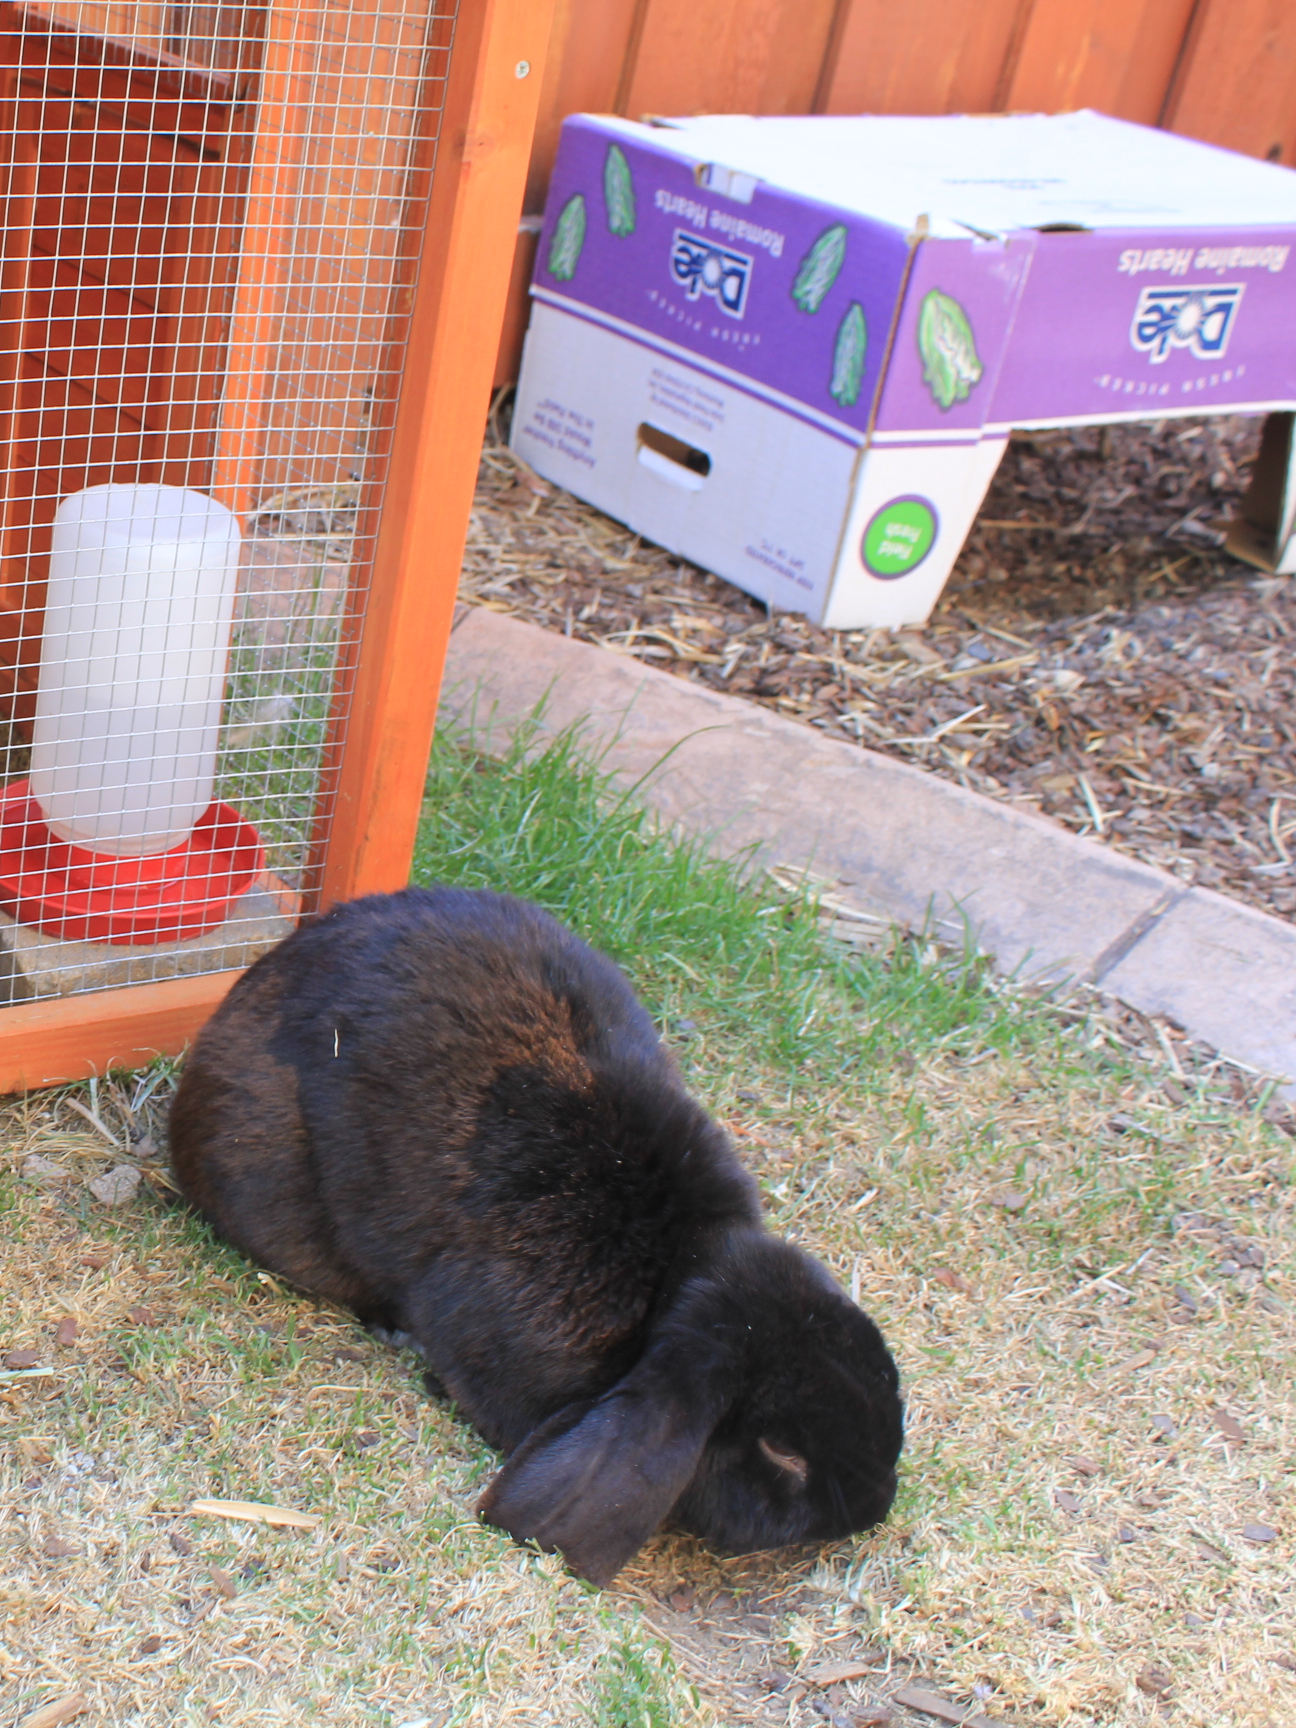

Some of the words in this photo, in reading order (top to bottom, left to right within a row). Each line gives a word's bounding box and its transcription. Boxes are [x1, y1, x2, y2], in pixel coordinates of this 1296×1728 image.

[655, 188, 708, 229] Hearts
[709, 209, 785, 258] Romaine
[1116, 248, 1195, 276] Hearts
[1194, 245, 1290, 273] Romaine
[669, 243, 747, 320] Dole
[1129, 303, 1234, 364] Dole
[876, 539, 913, 560] Field
